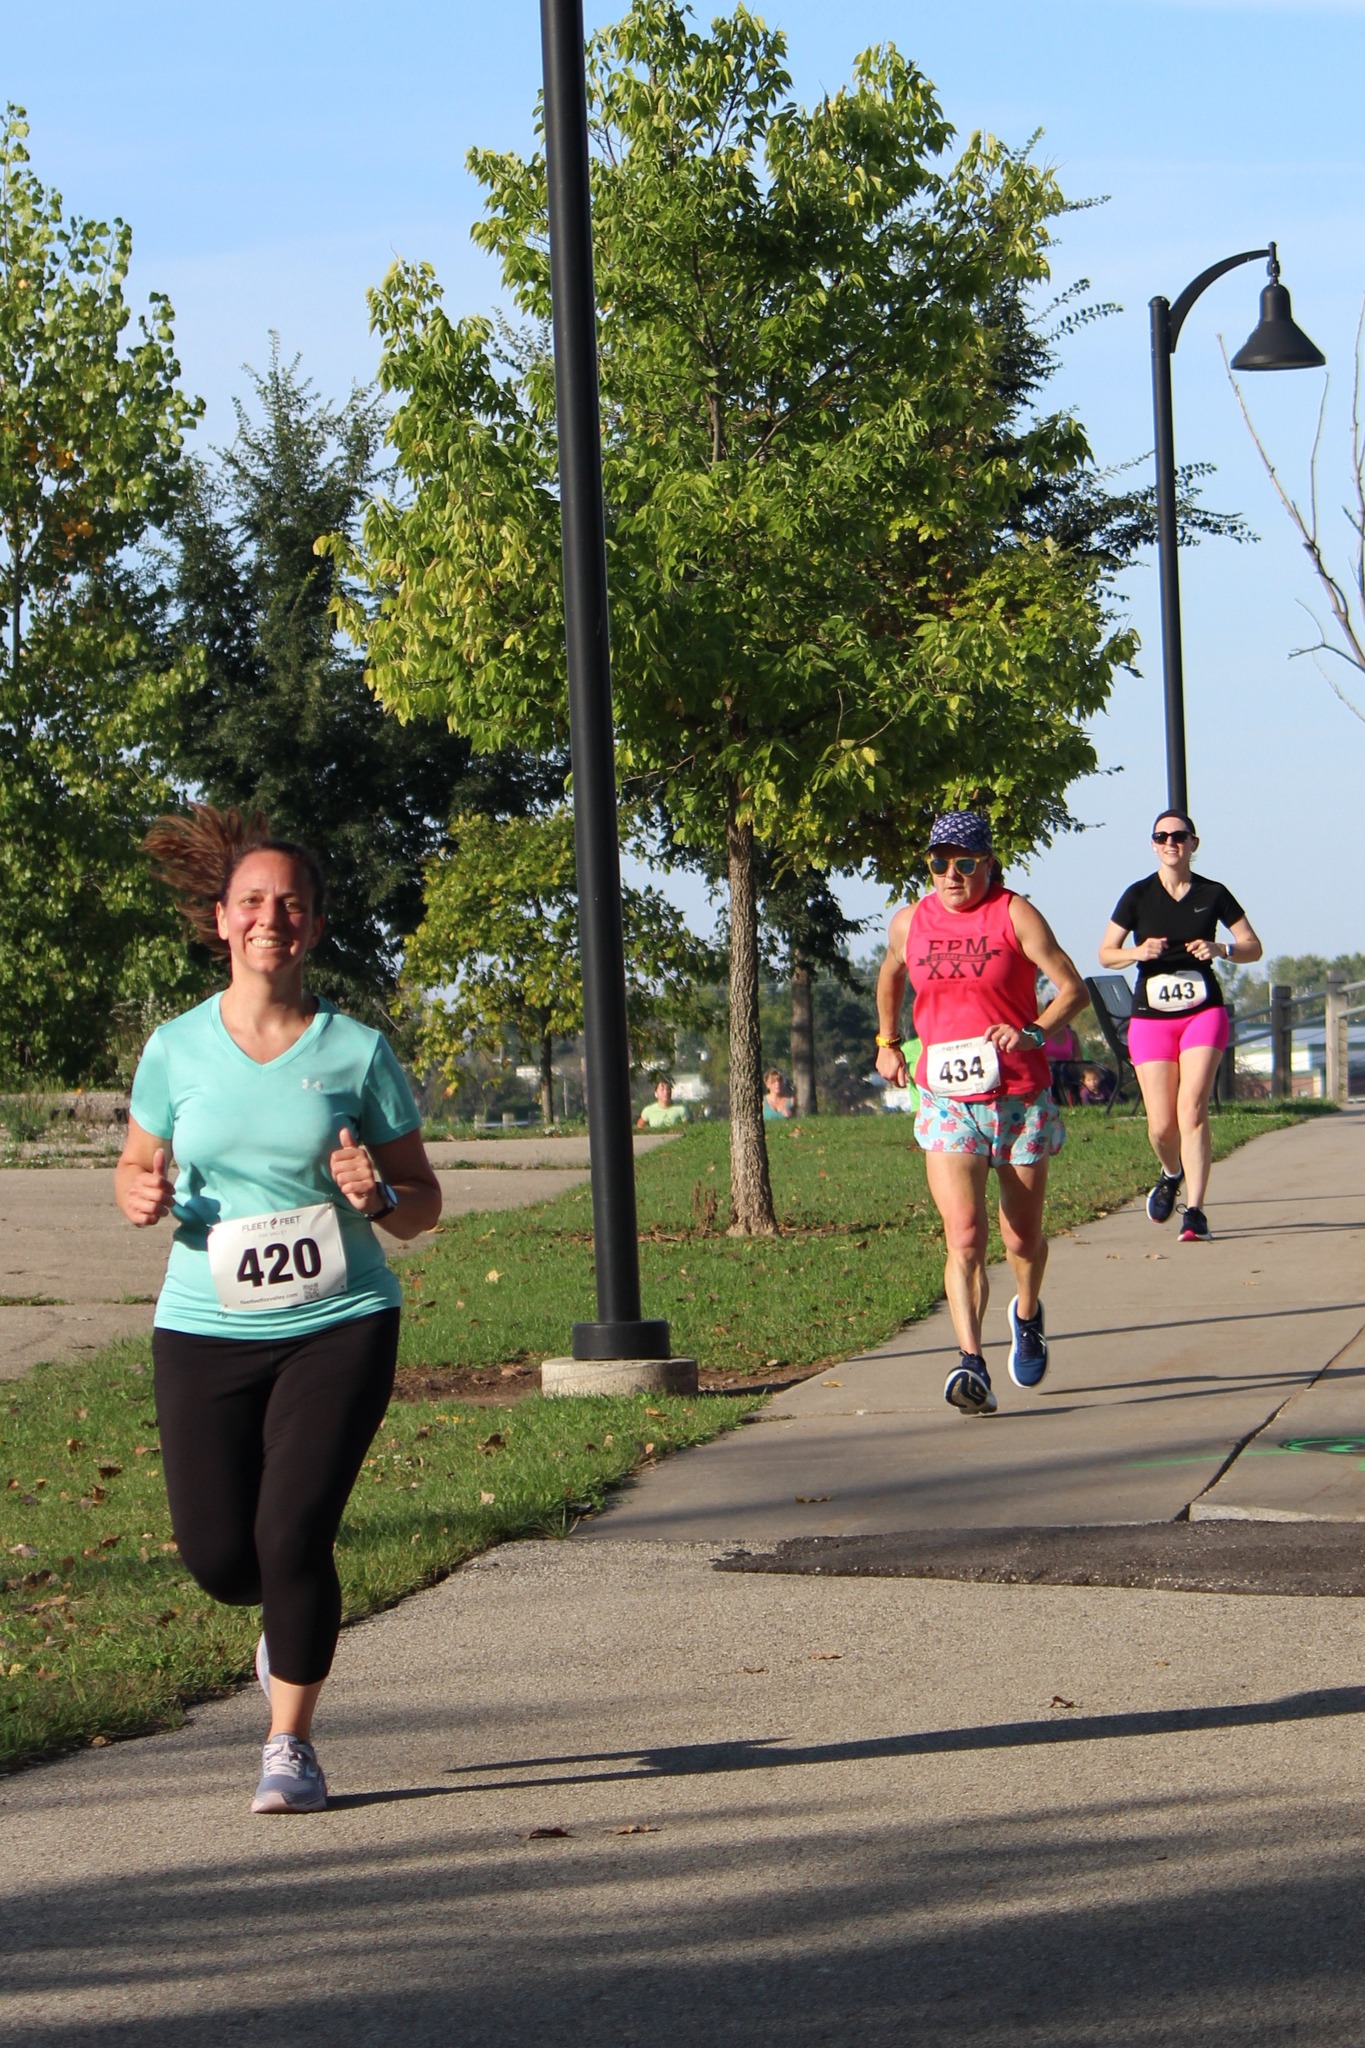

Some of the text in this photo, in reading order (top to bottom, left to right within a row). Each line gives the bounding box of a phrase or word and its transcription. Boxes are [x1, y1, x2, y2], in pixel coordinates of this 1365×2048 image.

[929, 936, 988, 954] FPM
[928, 961, 986, 980] XXV
[1159, 982, 1195, 1002] 443
[939, 1056, 985, 1084] 434
[241, 1215, 301, 1232] FLEET FEET
[237, 1238, 321, 1288] 420
